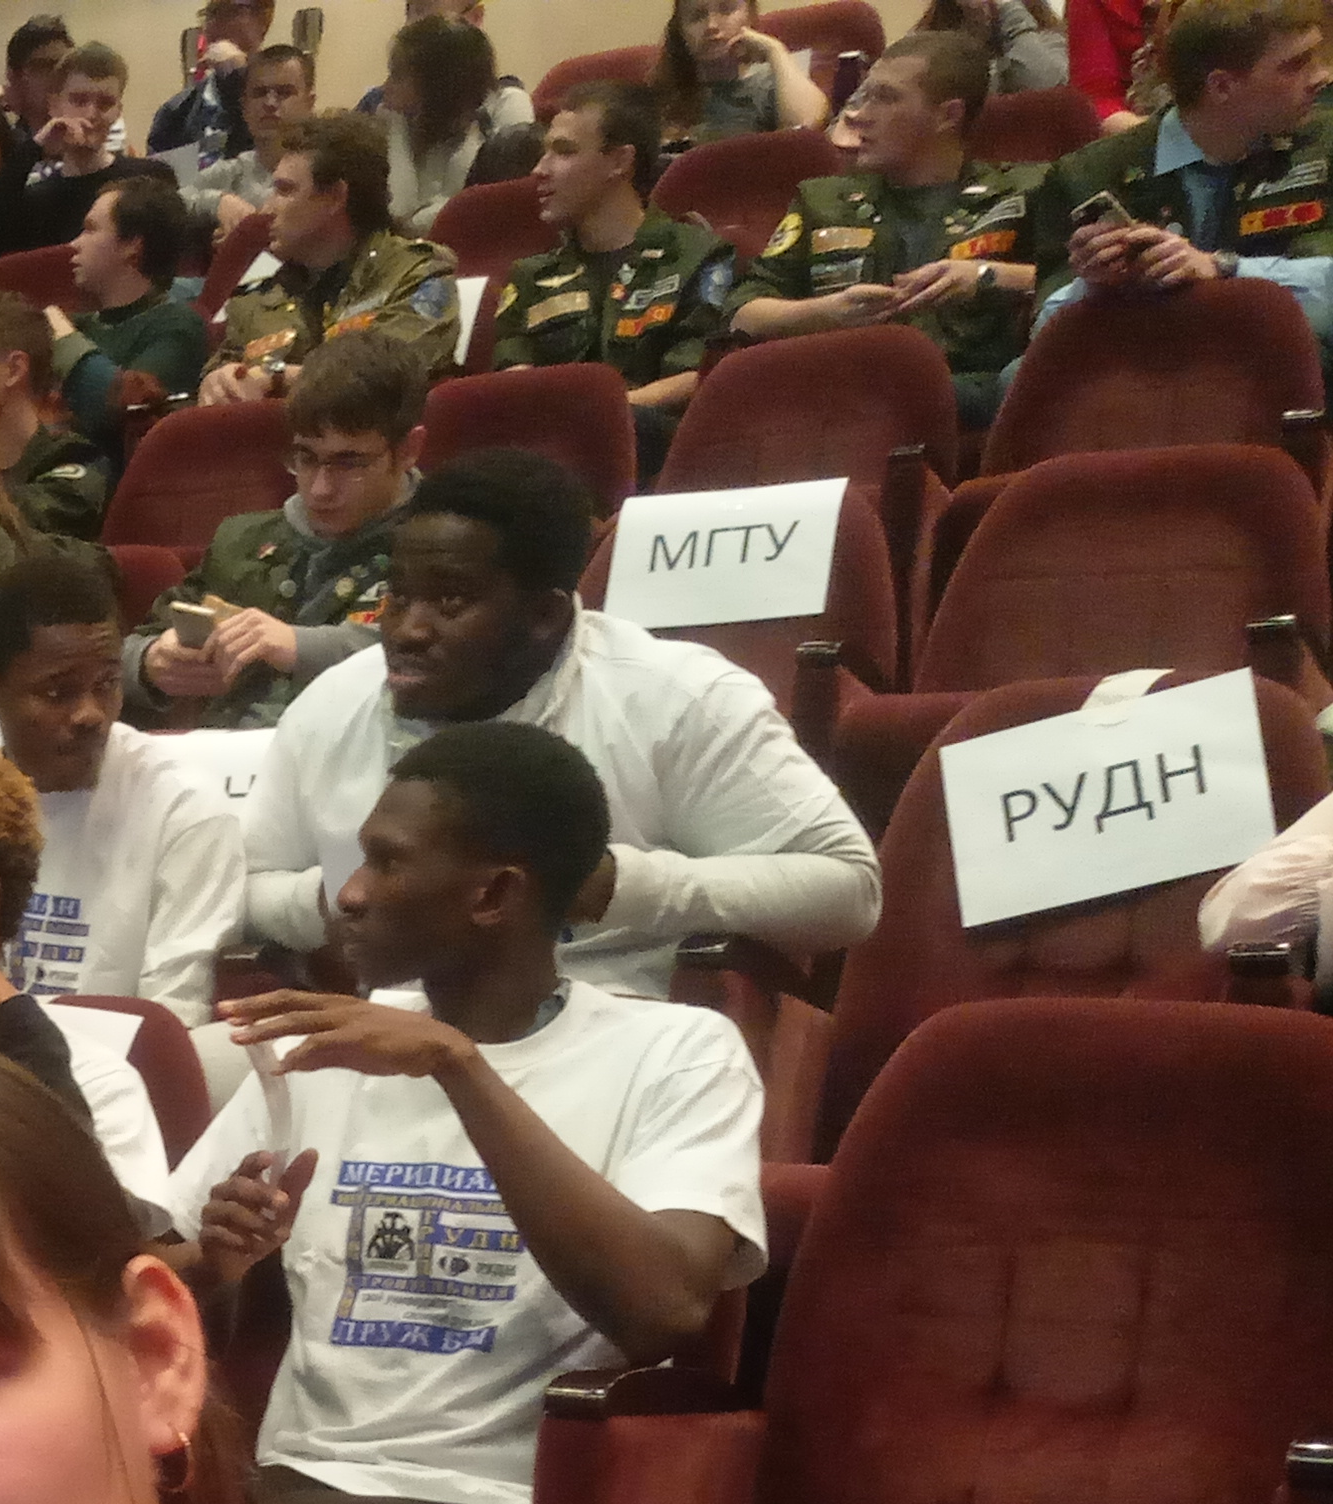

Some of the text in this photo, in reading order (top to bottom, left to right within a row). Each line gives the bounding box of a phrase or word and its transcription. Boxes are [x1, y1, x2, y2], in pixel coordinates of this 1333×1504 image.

[649, 519, 801, 573] МГТУ
[1000, 744, 1207, 842] РУДН
[343, 1164, 499, 1191] МЕРИДИА
